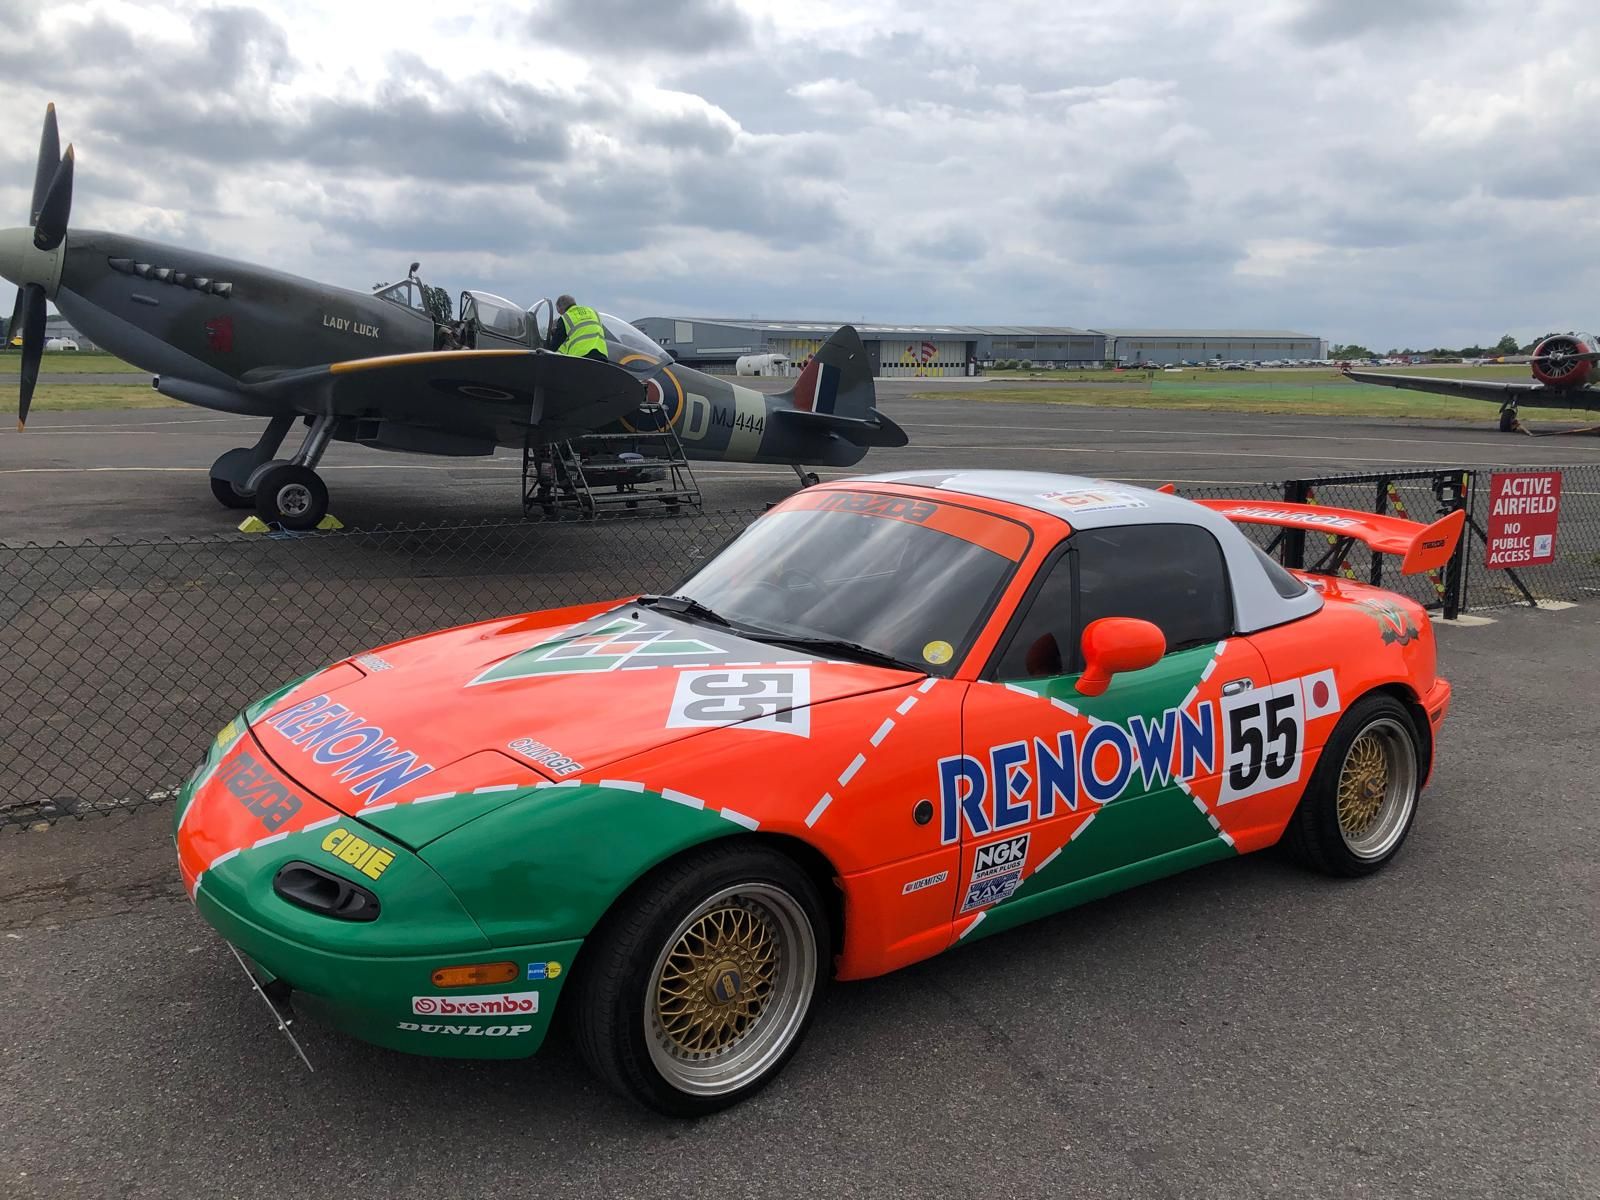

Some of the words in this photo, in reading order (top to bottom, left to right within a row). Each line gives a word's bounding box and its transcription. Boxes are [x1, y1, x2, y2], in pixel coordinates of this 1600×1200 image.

[323, 315, 350, 331] LADY
[353, 322, 380, 338] LUCK
[681, 392, 711, 440] D
[712, 405, 764, 435] MJ444
[1501, 478, 1552, 496] ACTIVE
[1492, 496, 1556, 516] AIRFIELD
[1503, 523, 1521, 535] NO
[1492, 536, 1531, 550] PUBLIC
[1489, 549, 1531, 564] ACCESS
[683, 673, 793, 724] 55
[265, 694, 436, 805] RENOWN
[1228, 693, 1298, 792] 55
[508, 737, 584, 776] CHARGE
[938, 700, 1215, 845] RENOWN
[976, 838, 1025, 870] NGK
[976, 867, 998, 879] SPARK
[998, 861, 1021, 872] PLUGS
[912, 872, 947, 890] IDEMITSU
[965, 879, 1018, 905] RAYS
[440, 996, 534, 1014] brembo
[396, 1021, 532, 1037] DUNLOP
